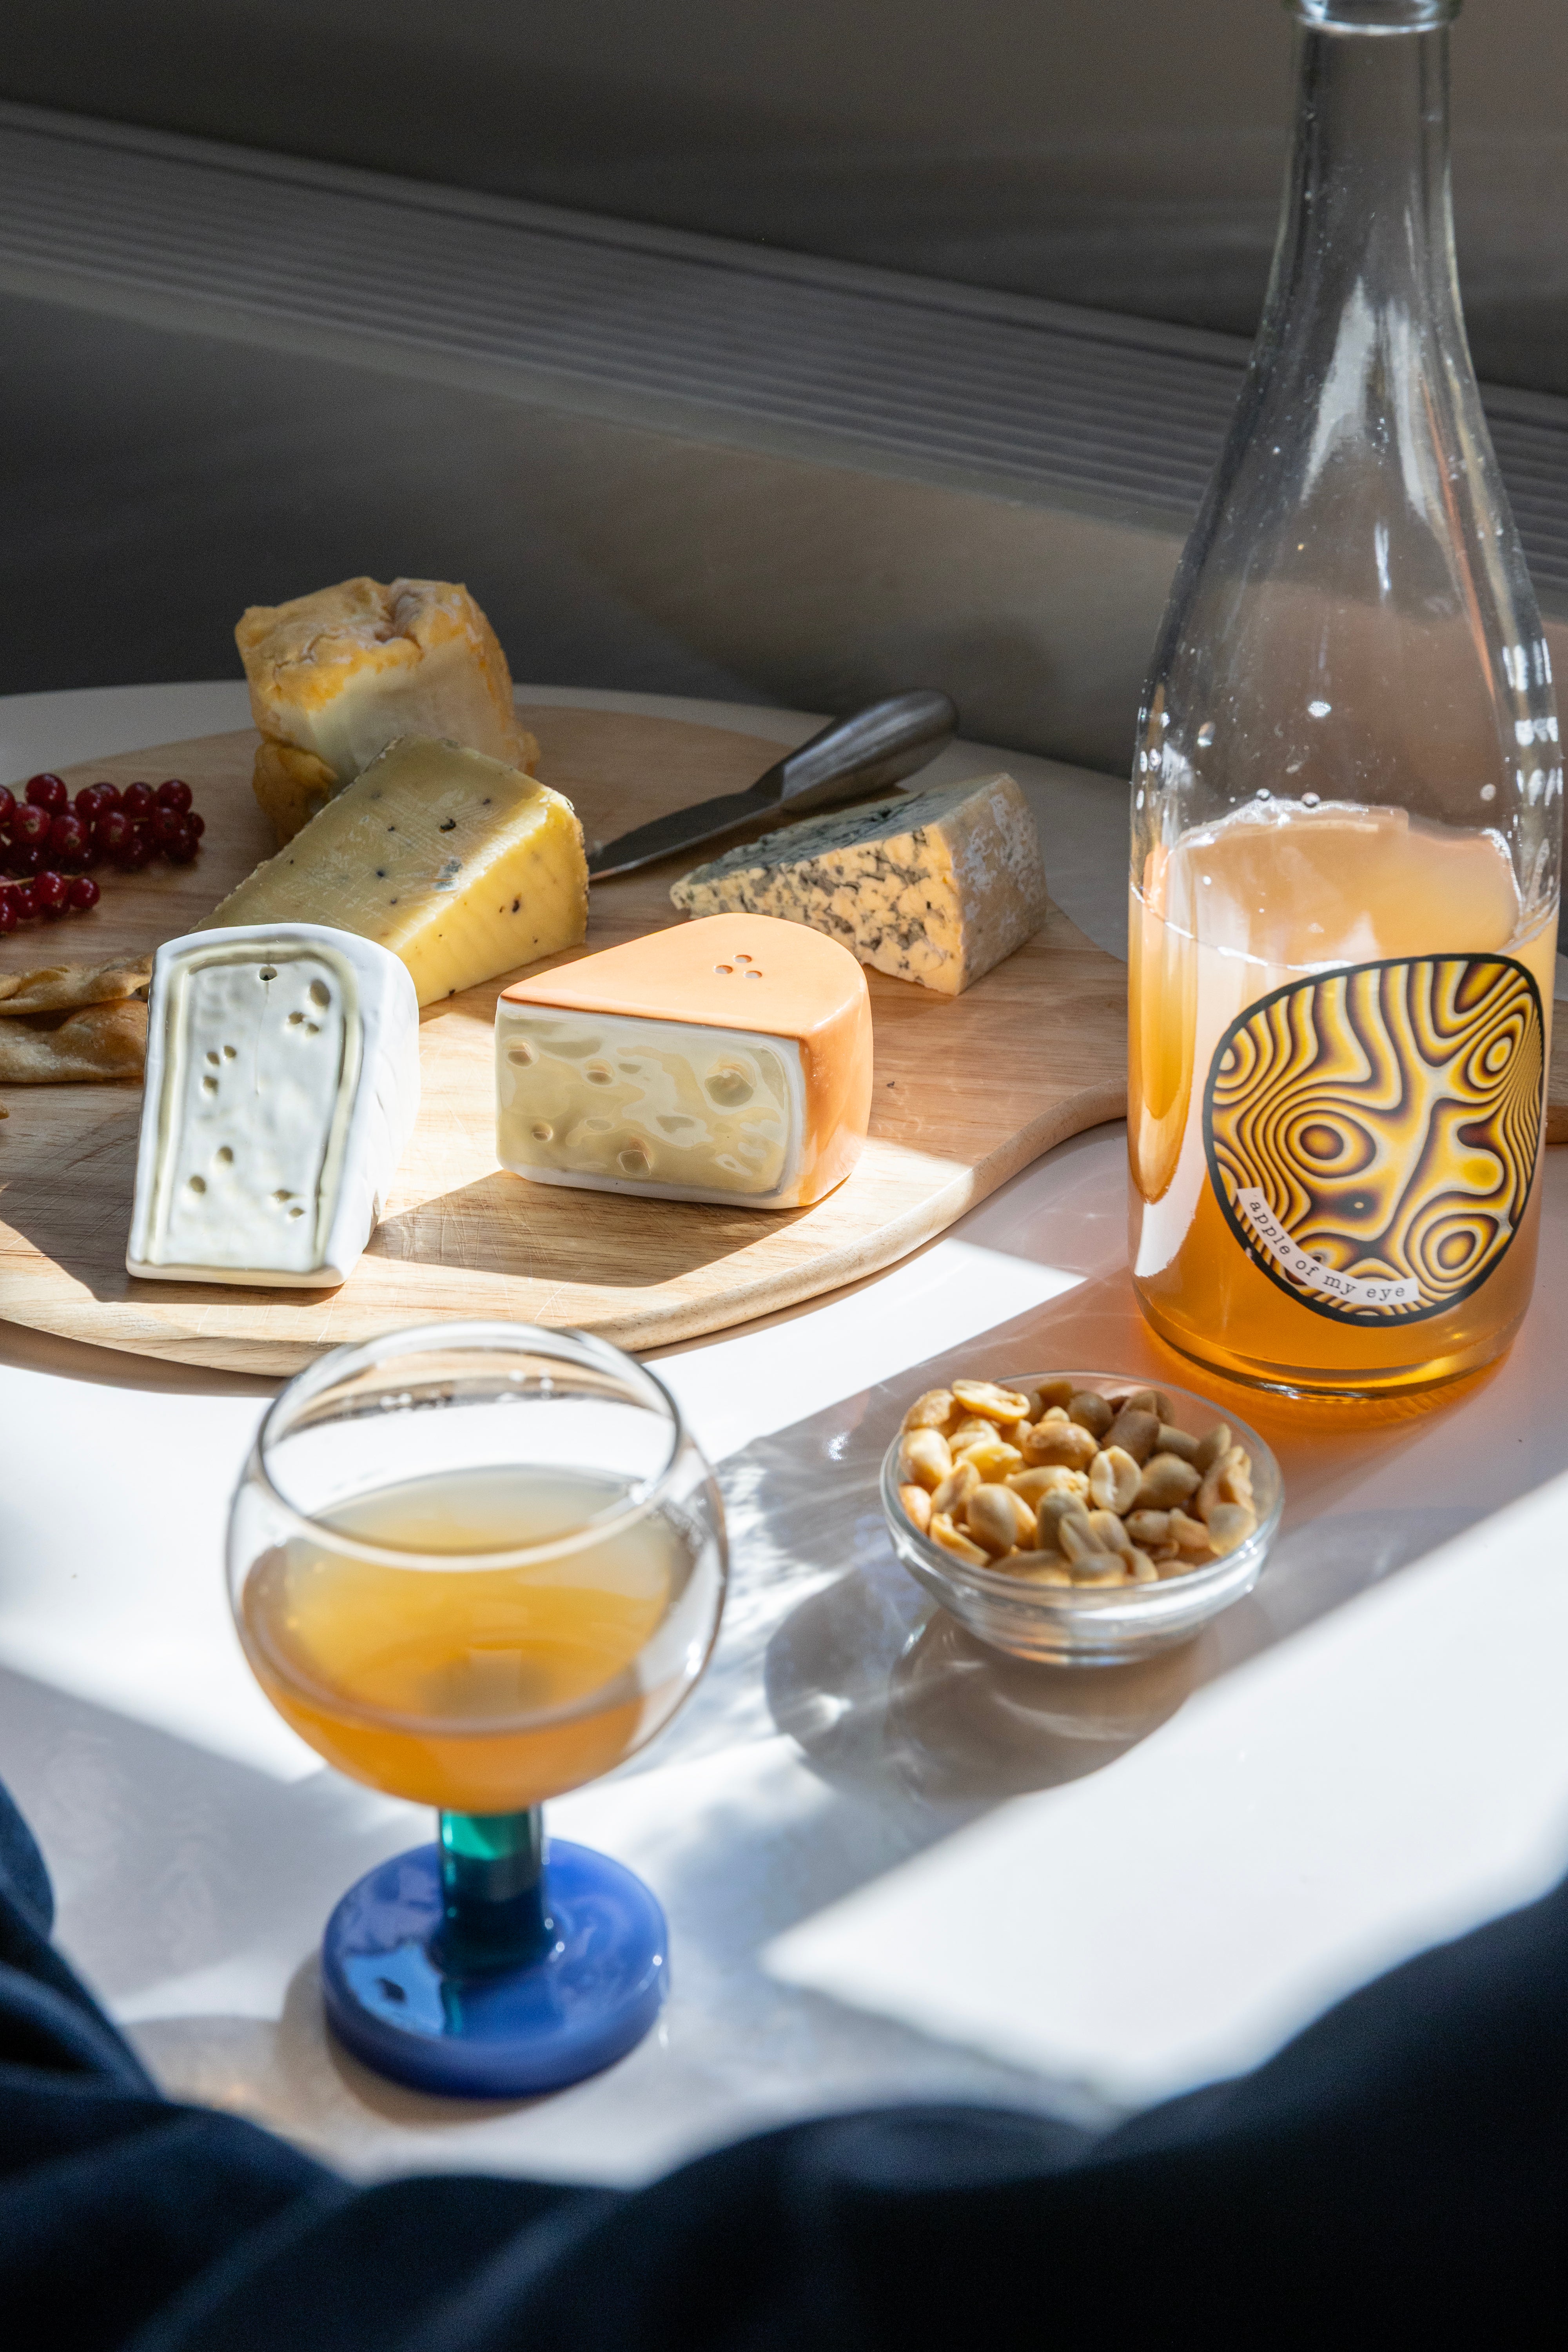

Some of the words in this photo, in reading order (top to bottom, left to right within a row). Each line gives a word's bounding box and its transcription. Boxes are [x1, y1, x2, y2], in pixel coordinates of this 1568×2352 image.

[1249, 1201, 1290, 1254] apple
[1296, 1260, 1320, 1276] of
[1323, 1275, 1357, 1295] my
[1367, 1286, 1405, 1301] eye
